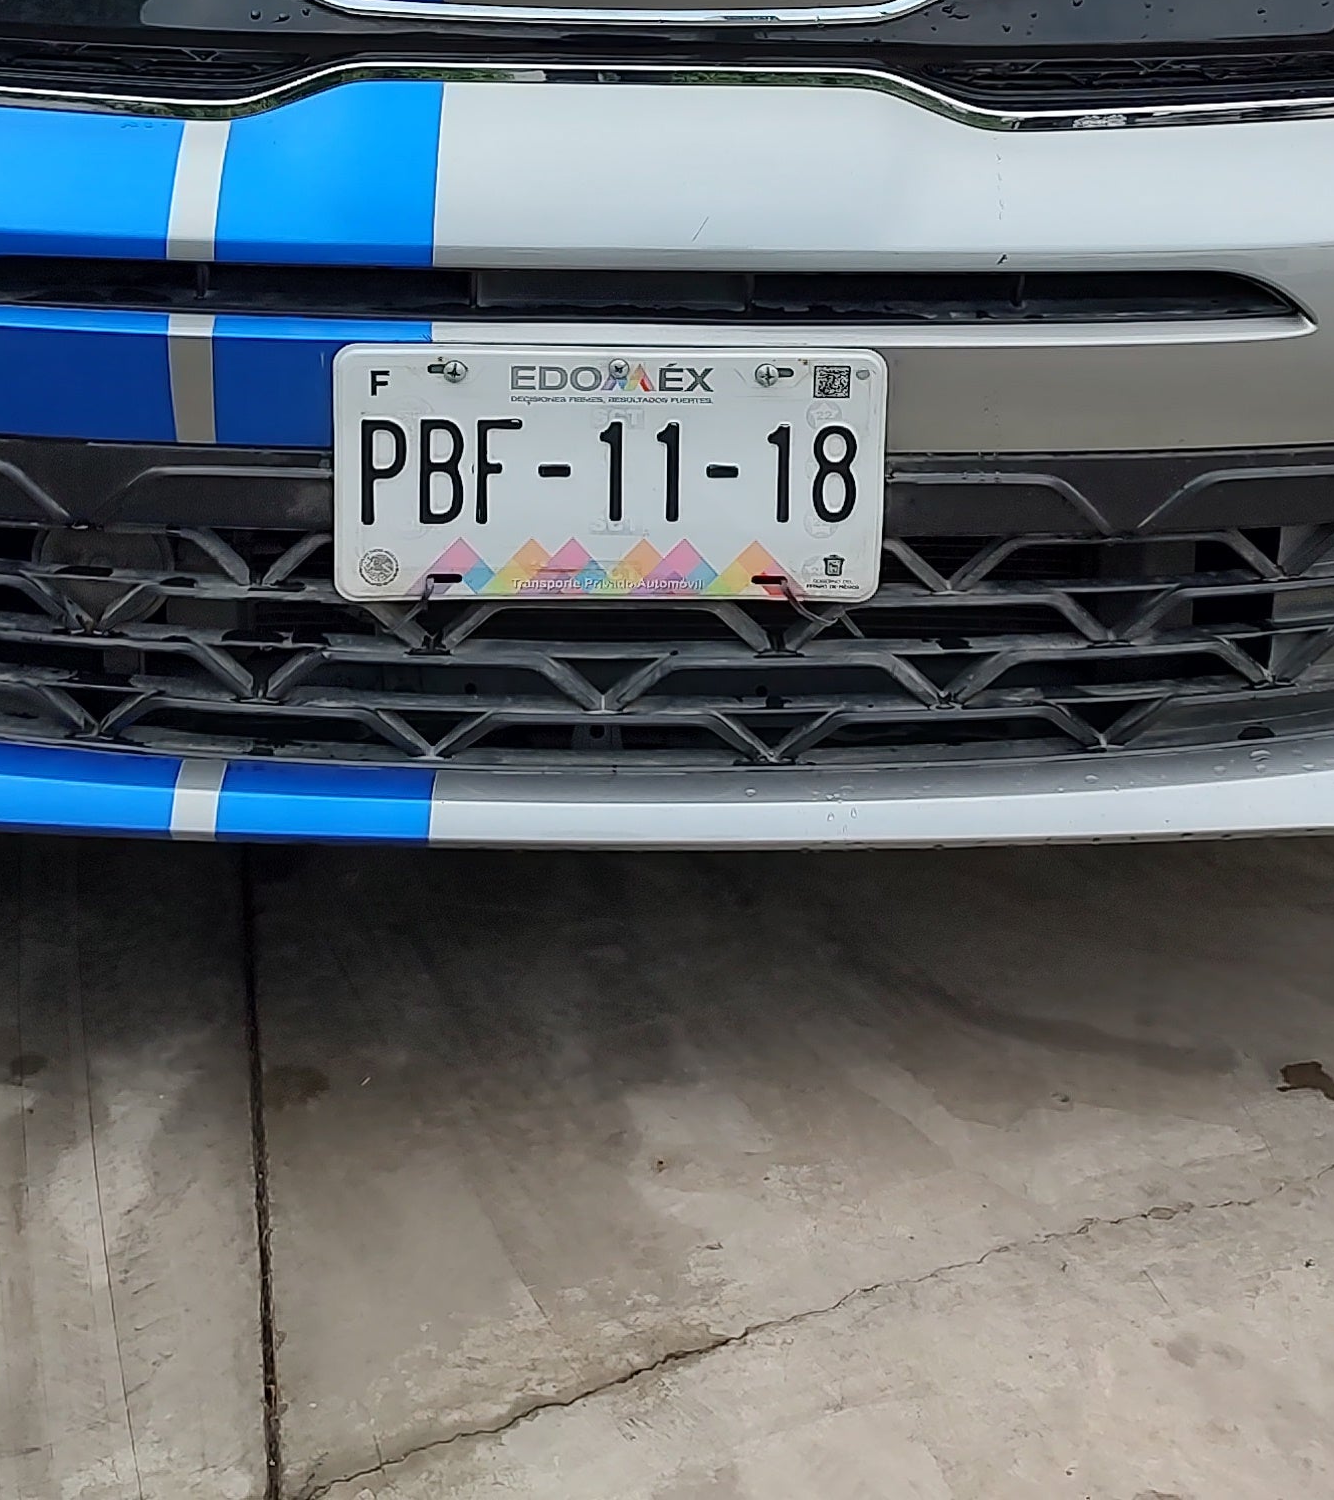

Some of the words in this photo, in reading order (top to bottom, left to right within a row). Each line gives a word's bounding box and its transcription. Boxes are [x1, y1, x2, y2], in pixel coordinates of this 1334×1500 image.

[370, 370, 391, 396] F
[360, 418, 858, 525] PBF-11-18
[512, 577, 581, 593] Transporte
